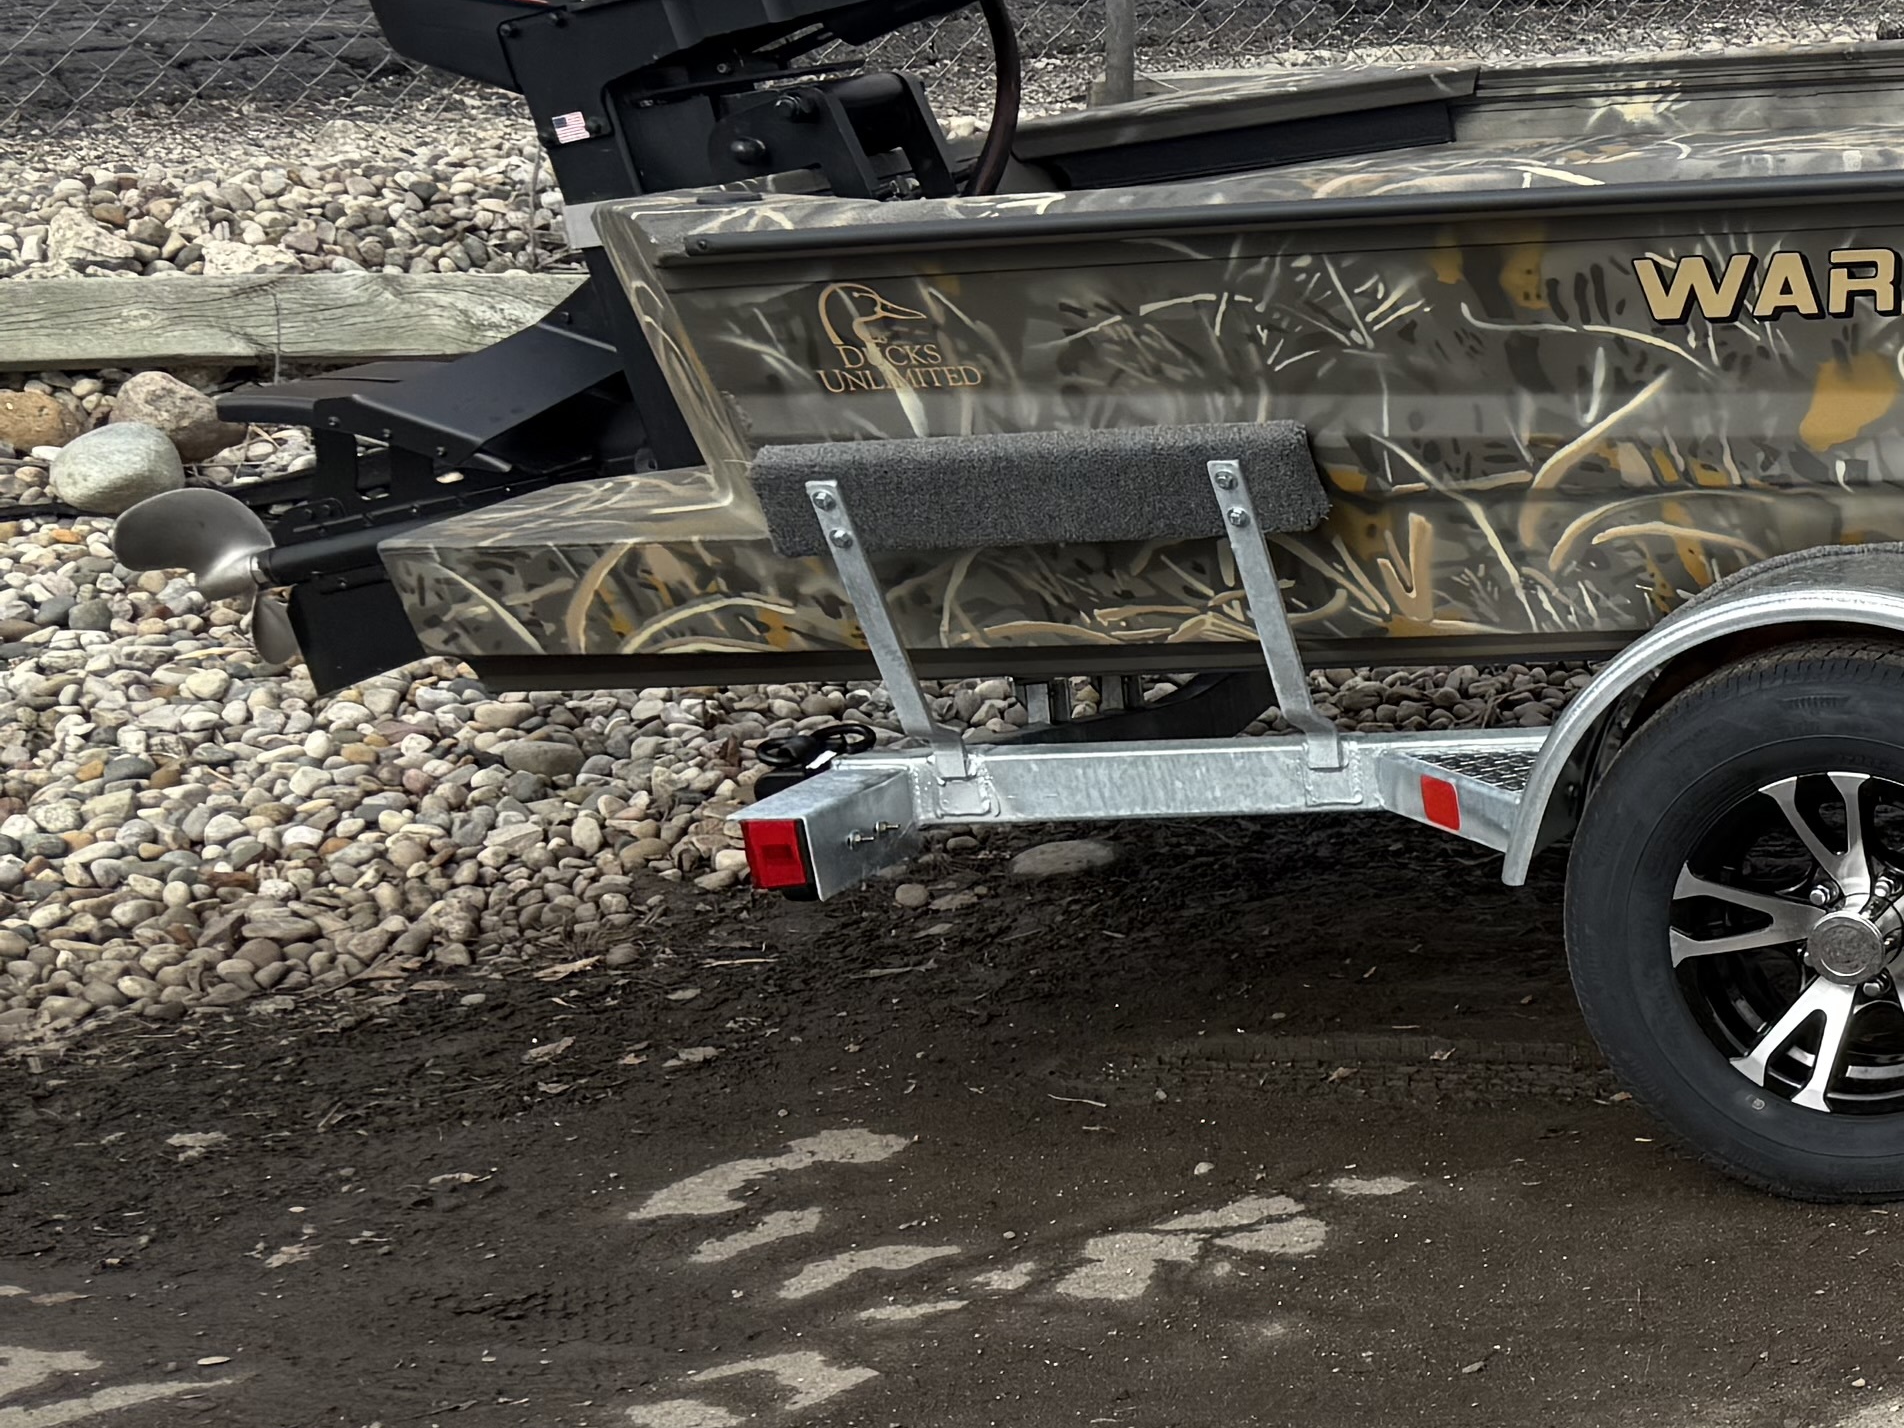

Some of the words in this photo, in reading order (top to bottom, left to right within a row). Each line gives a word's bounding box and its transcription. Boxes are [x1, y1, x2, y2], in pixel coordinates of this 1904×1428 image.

[1632, 247, 1902, 325] WAR
[836, 343, 943, 369] DUCKS
[817, 364, 983, 393] UNLIMITED
